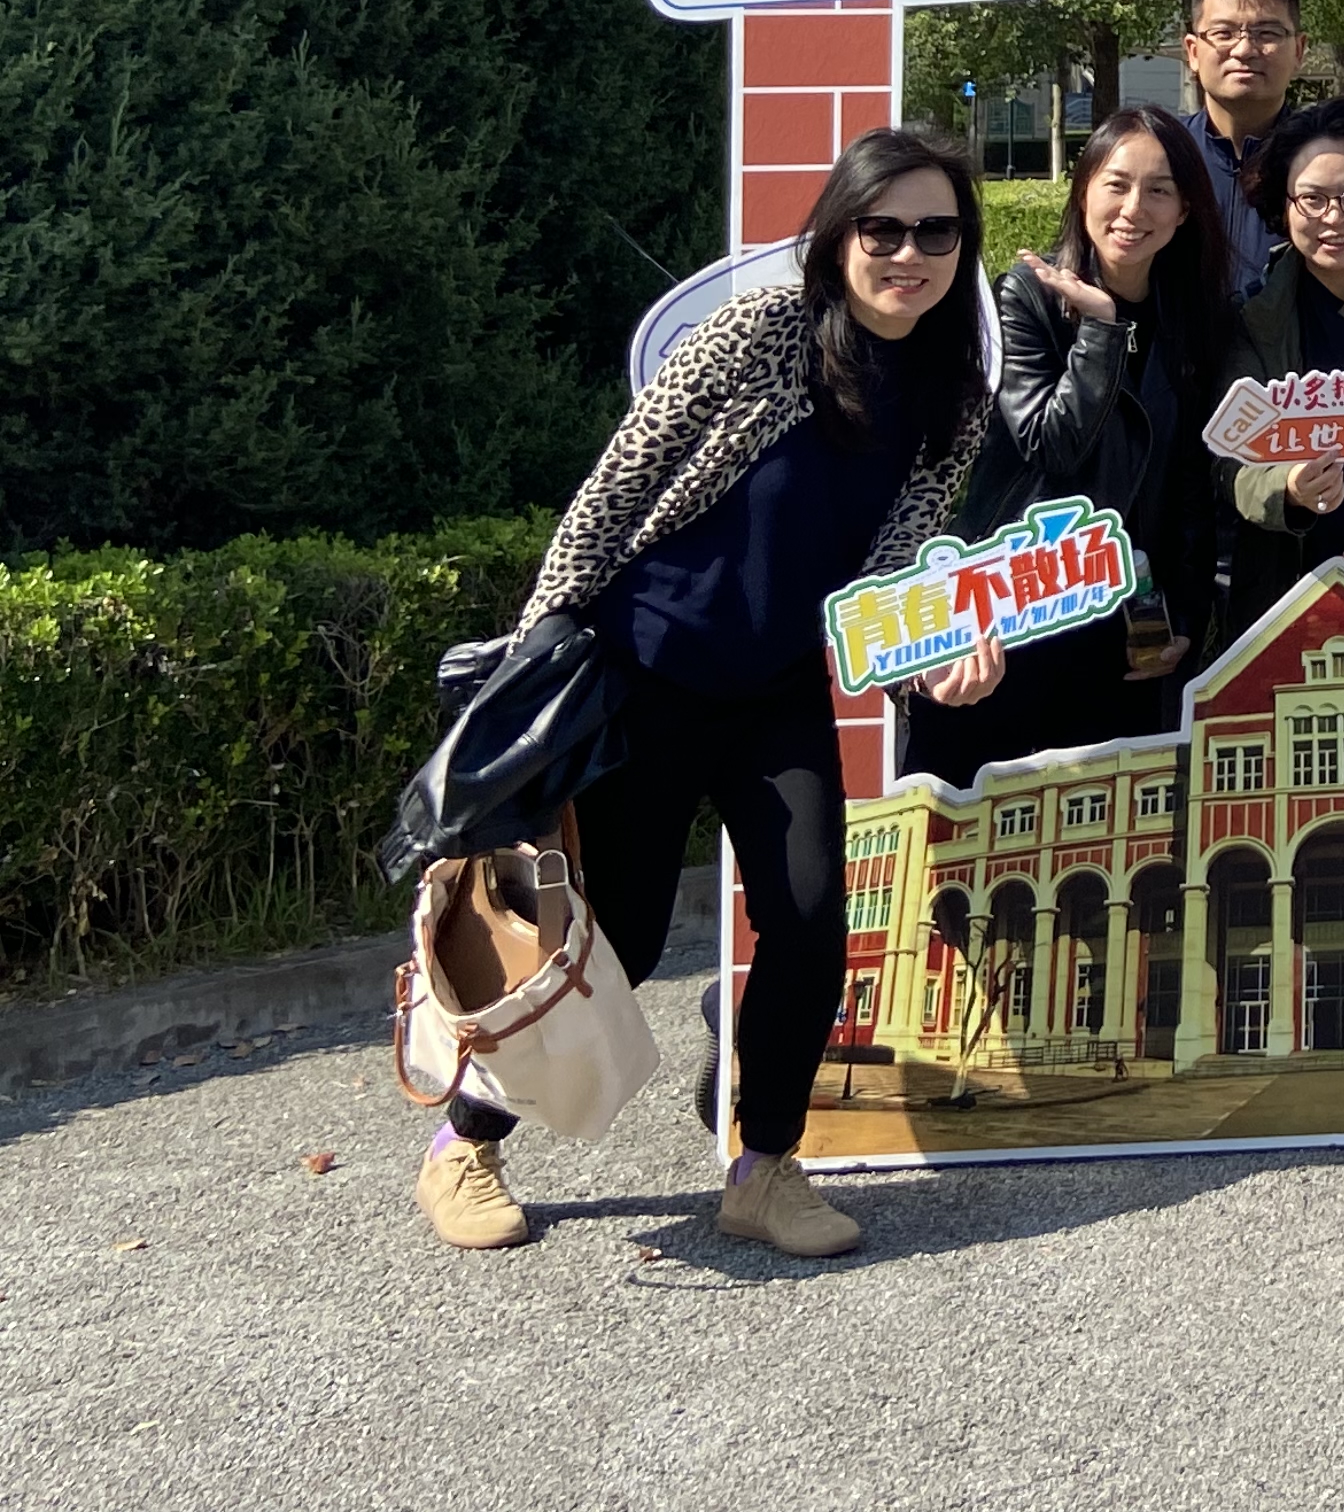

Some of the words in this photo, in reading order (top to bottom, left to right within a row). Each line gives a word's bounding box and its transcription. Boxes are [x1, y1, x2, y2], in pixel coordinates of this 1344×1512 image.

[1223, 402, 1265, 443] call
[839, 524, 1125, 681] 青春不散场
[874, 625, 972, 672] YOUNG
